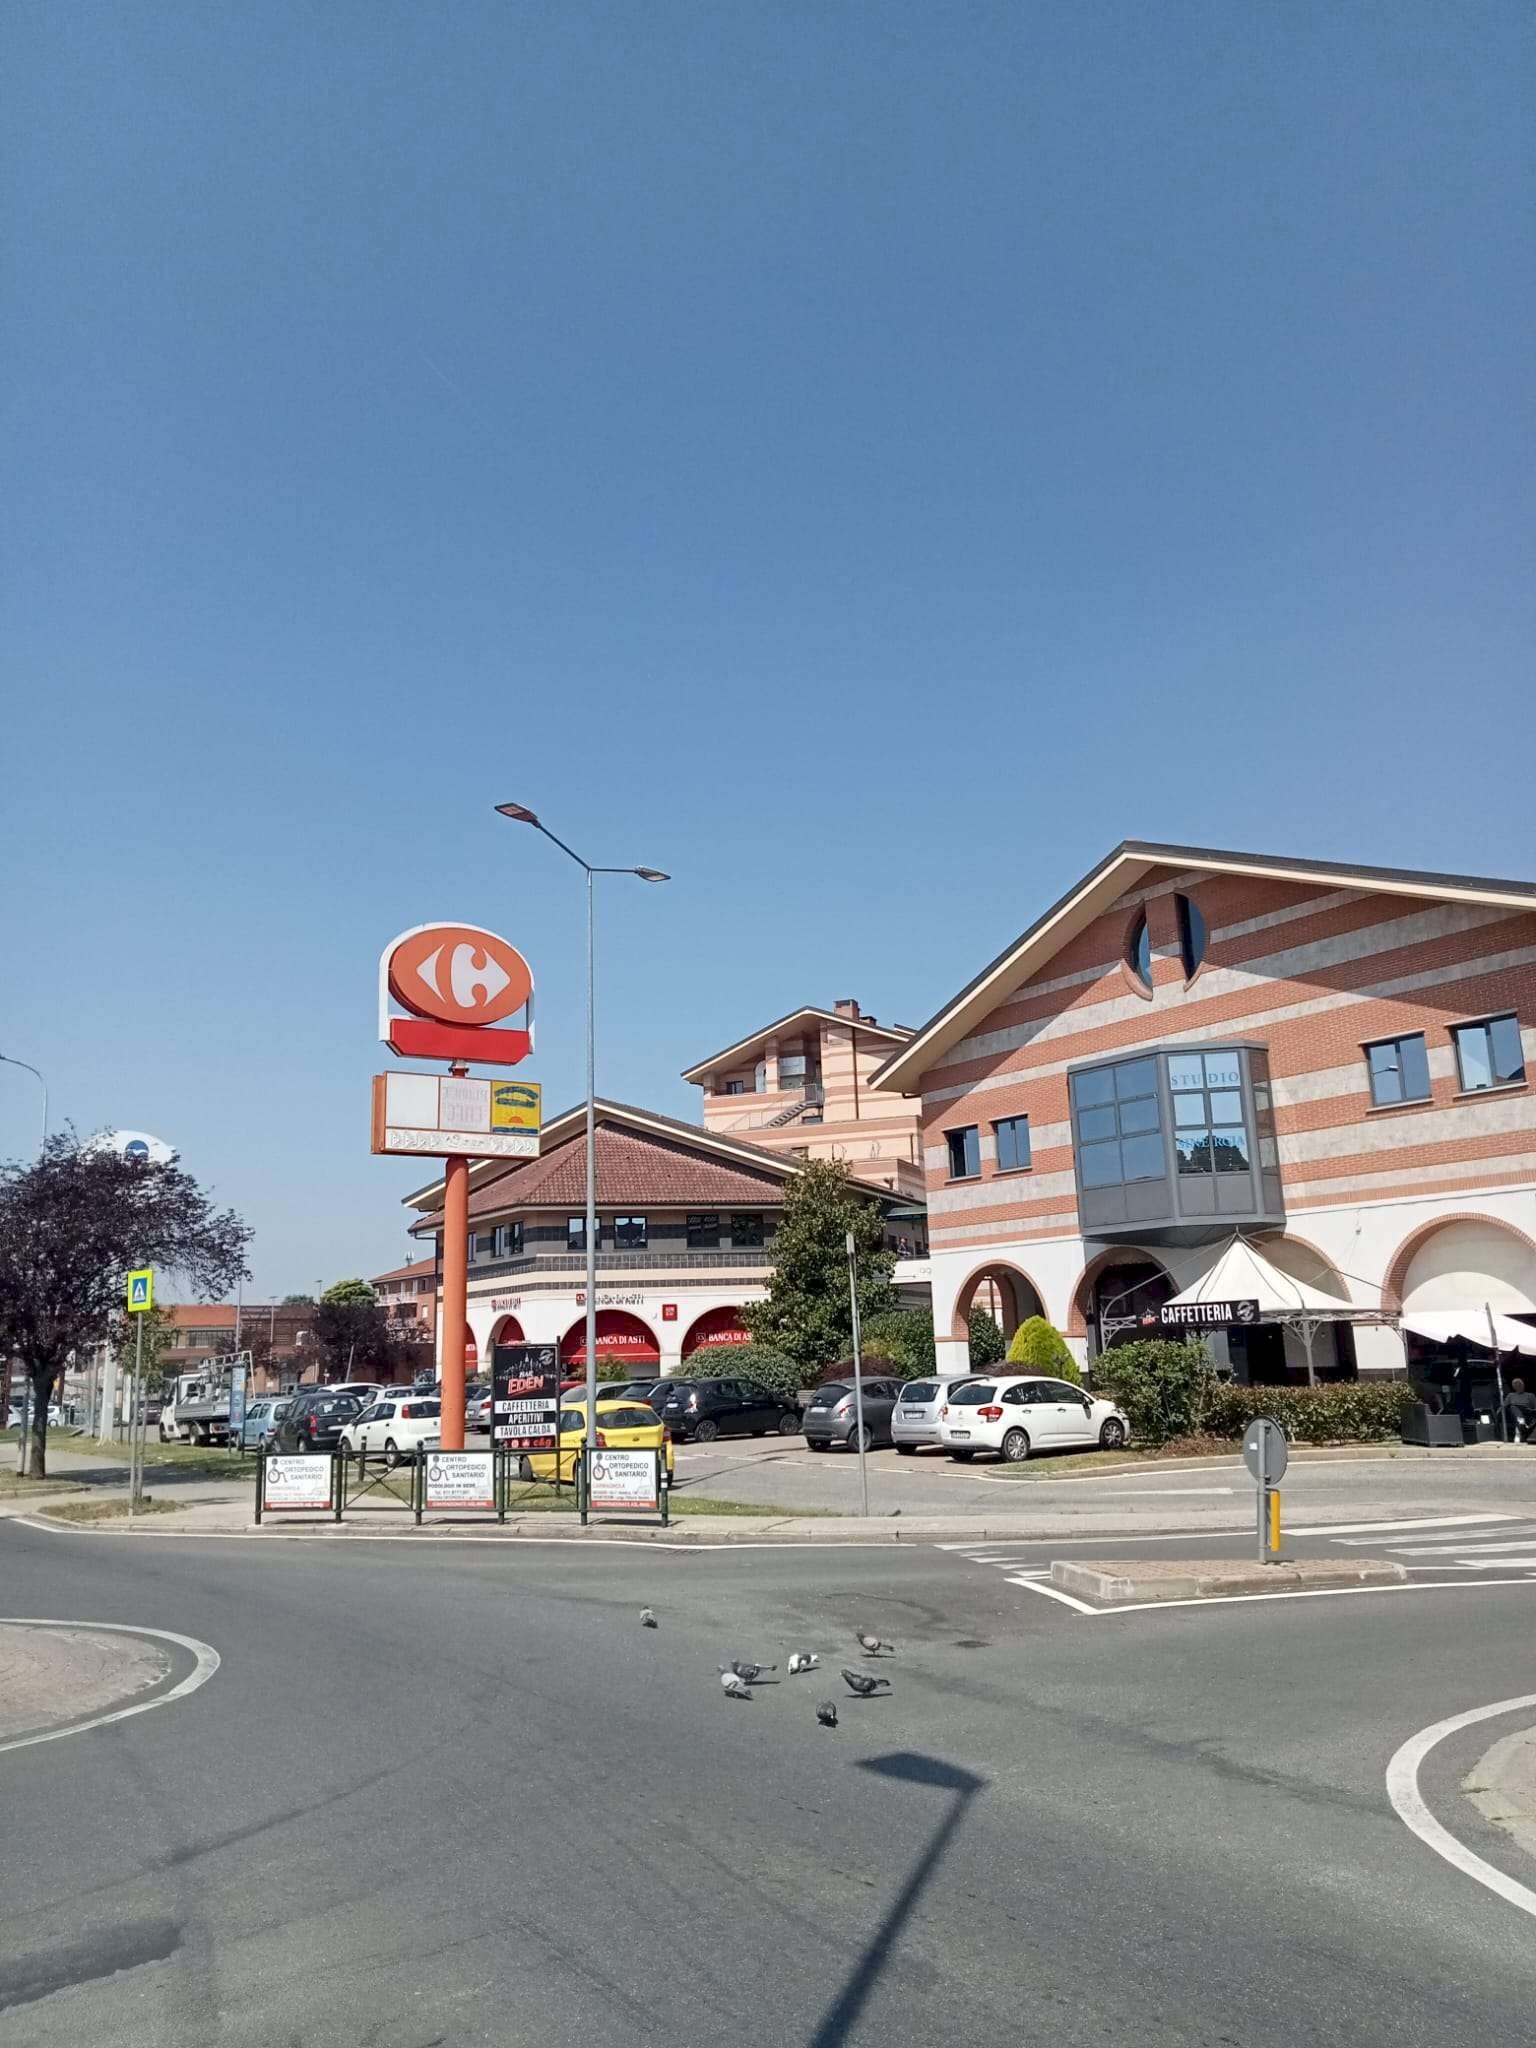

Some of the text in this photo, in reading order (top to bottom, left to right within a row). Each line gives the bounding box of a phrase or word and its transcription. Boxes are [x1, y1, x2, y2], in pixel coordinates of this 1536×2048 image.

[1171, 1072, 1239, 1085] STUDIO
[1161, 1303, 1233, 1324] CAFFETTERIA
[619, 1335, 627, 1344] DI
[628, 1335, 645, 1344] ASTI
[708, 1332, 752, 1342] BANCA DI AS
[508, 1375, 544, 1394] EDEN
[502, 1400, 550, 1412] CAFFETTERIA
[508, 1412, 544, 1425] APERITIVI
[500, 1424, 551, 1436] TAVOLA CALDA
[614, 1470, 647, 1478] SANITARIO
